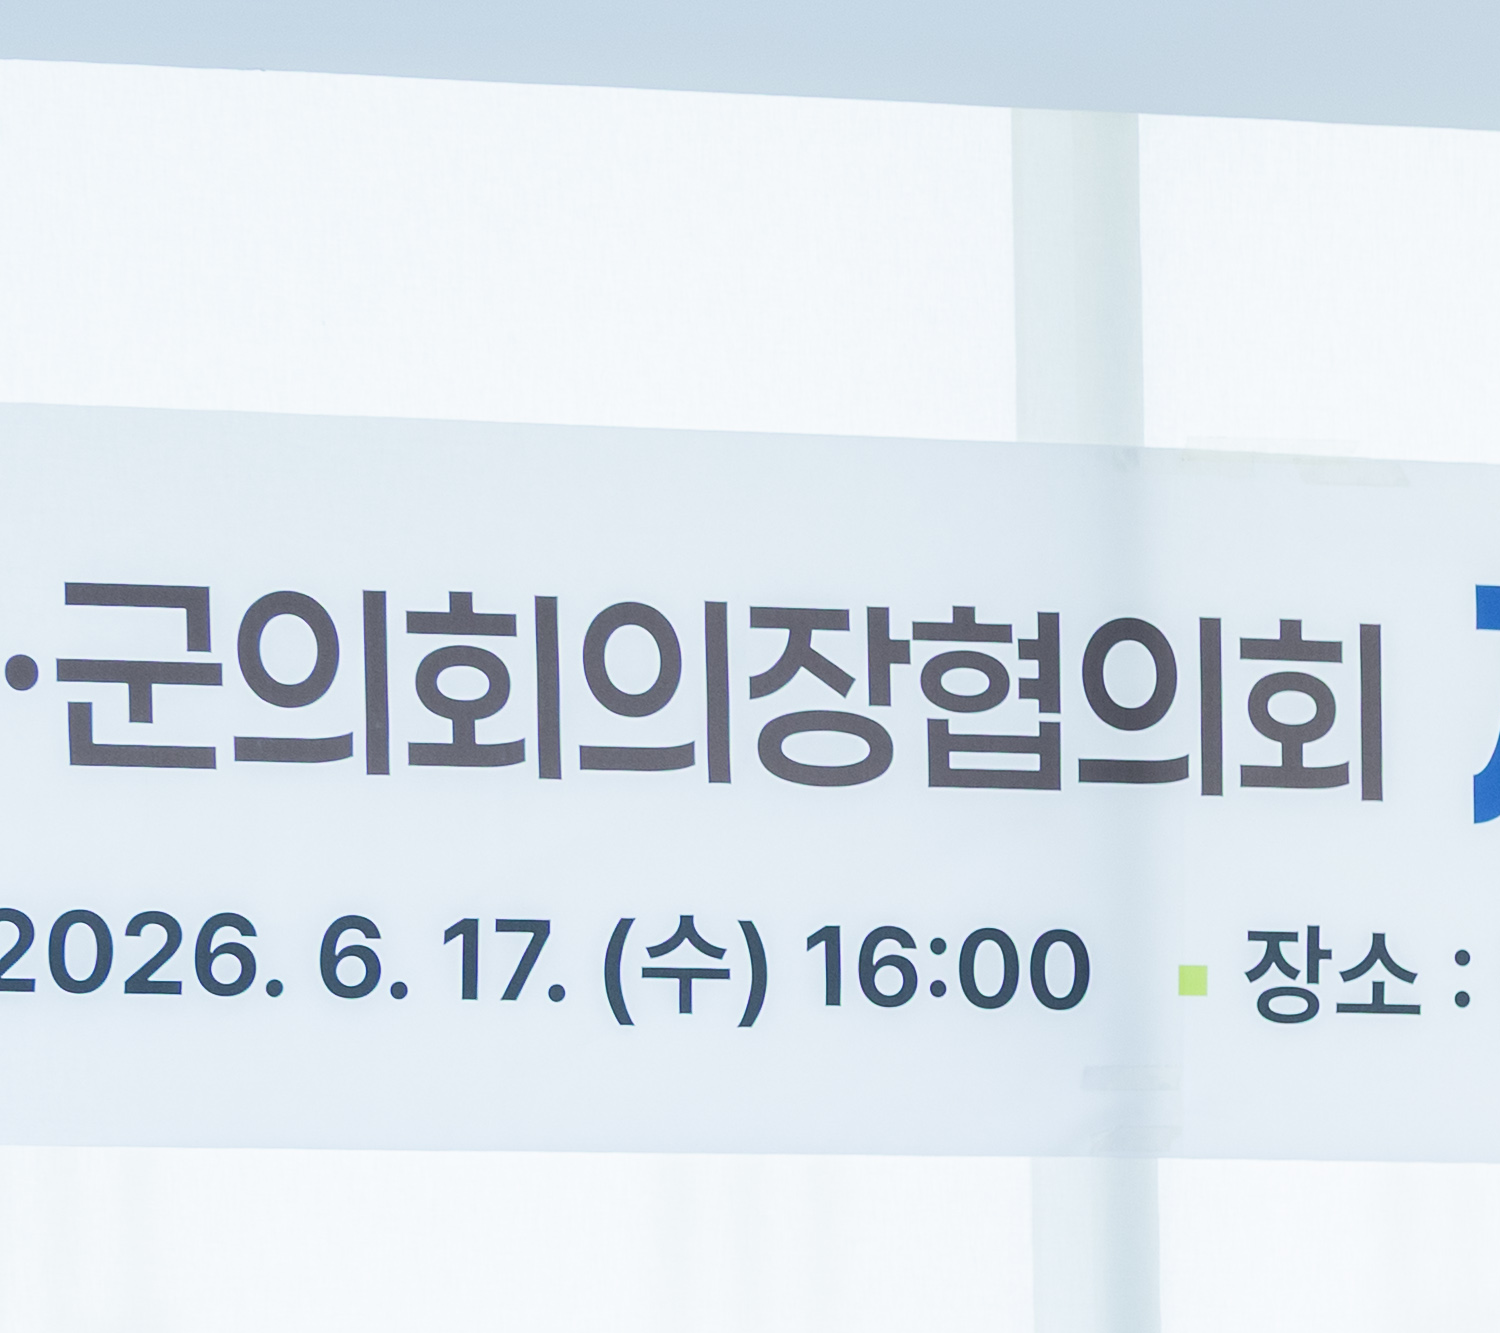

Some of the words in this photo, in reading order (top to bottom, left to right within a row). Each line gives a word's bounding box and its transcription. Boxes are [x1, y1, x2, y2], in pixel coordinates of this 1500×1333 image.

[0, 907, 284, 998] 2026.
[319, 914, 409, 1000] 6.
[443, 917, 566, 1003] 17.
[603, 914, 768, 1028] (수)
[806, 925, 1091, 1011] 16:00
[1244, 924, 1422, 1025] 장소
